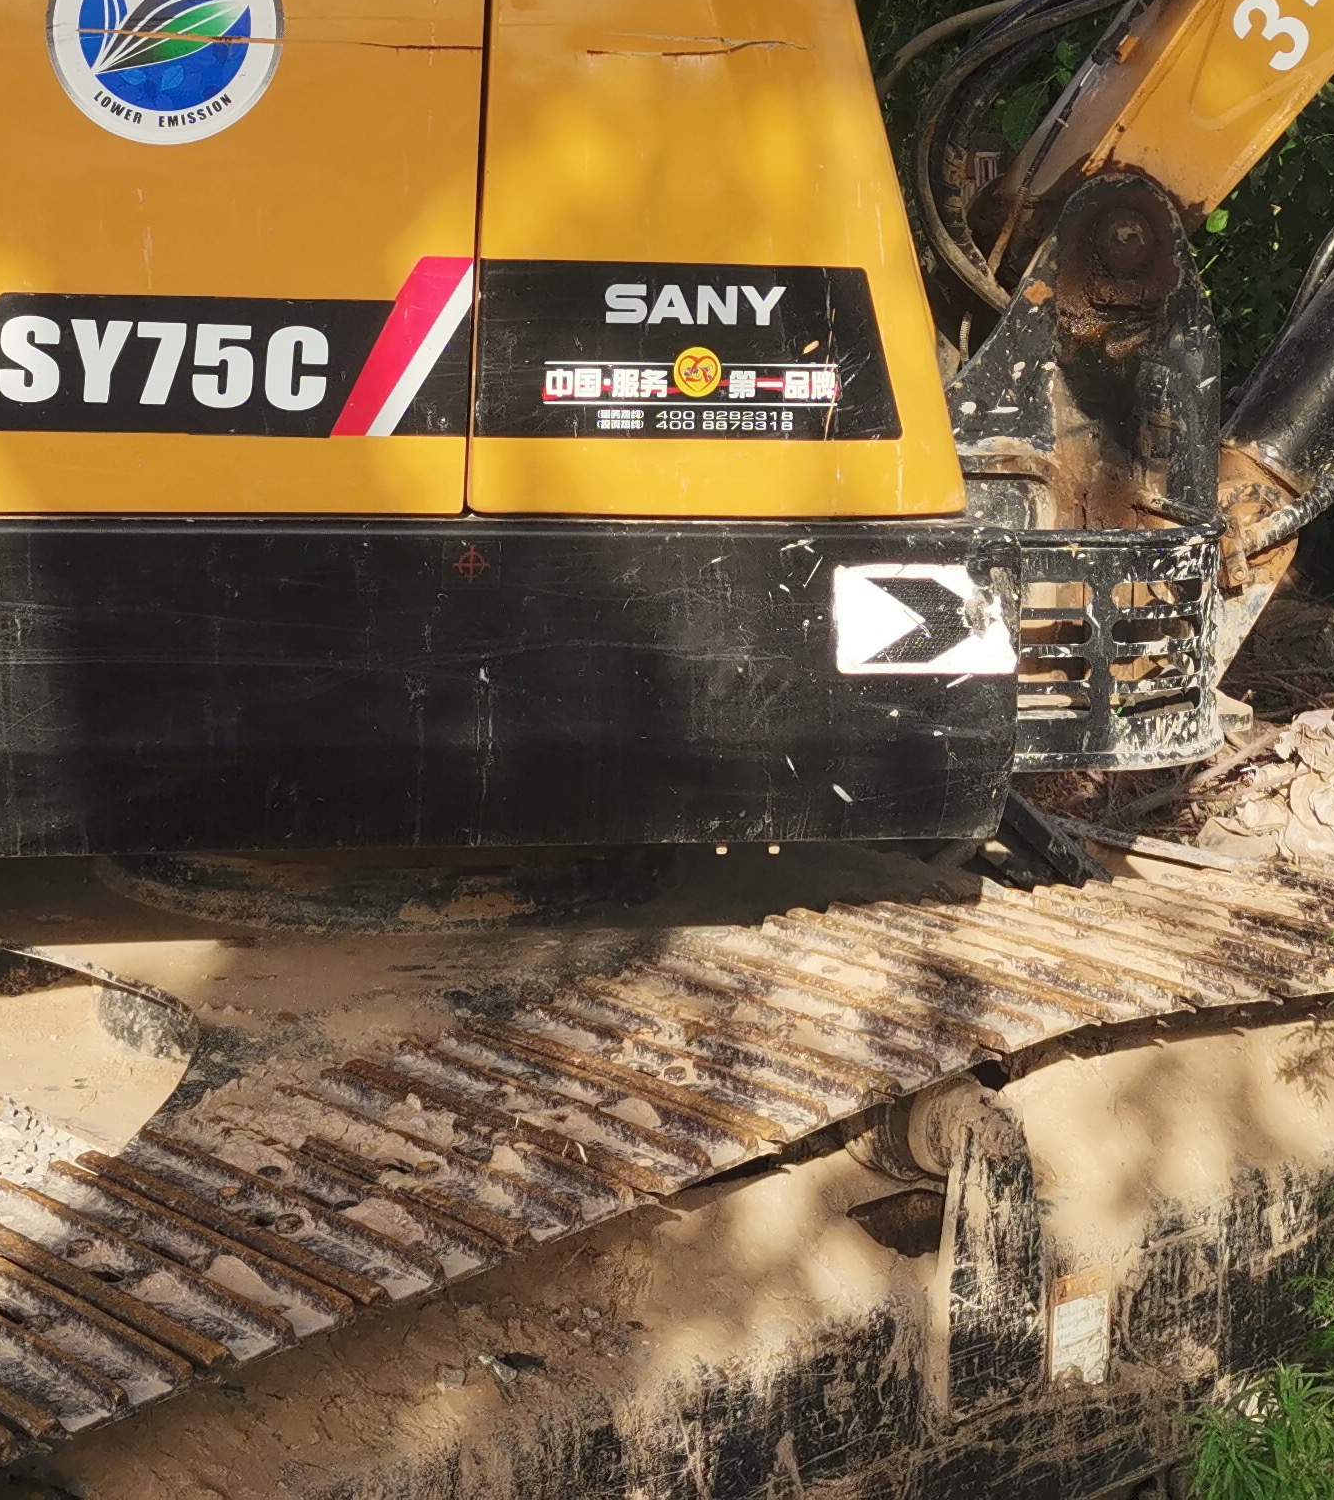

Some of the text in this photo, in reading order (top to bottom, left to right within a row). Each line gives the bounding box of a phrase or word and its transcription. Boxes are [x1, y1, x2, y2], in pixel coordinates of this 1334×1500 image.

[93, 90, 233, 128] LOWER EMISSION
[604, 283, 787, 326] SANY
[728, 369, 837, 400] 第一品牌
[655, 410, 696, 420] 400
[655, 420, 696, 430] 400
